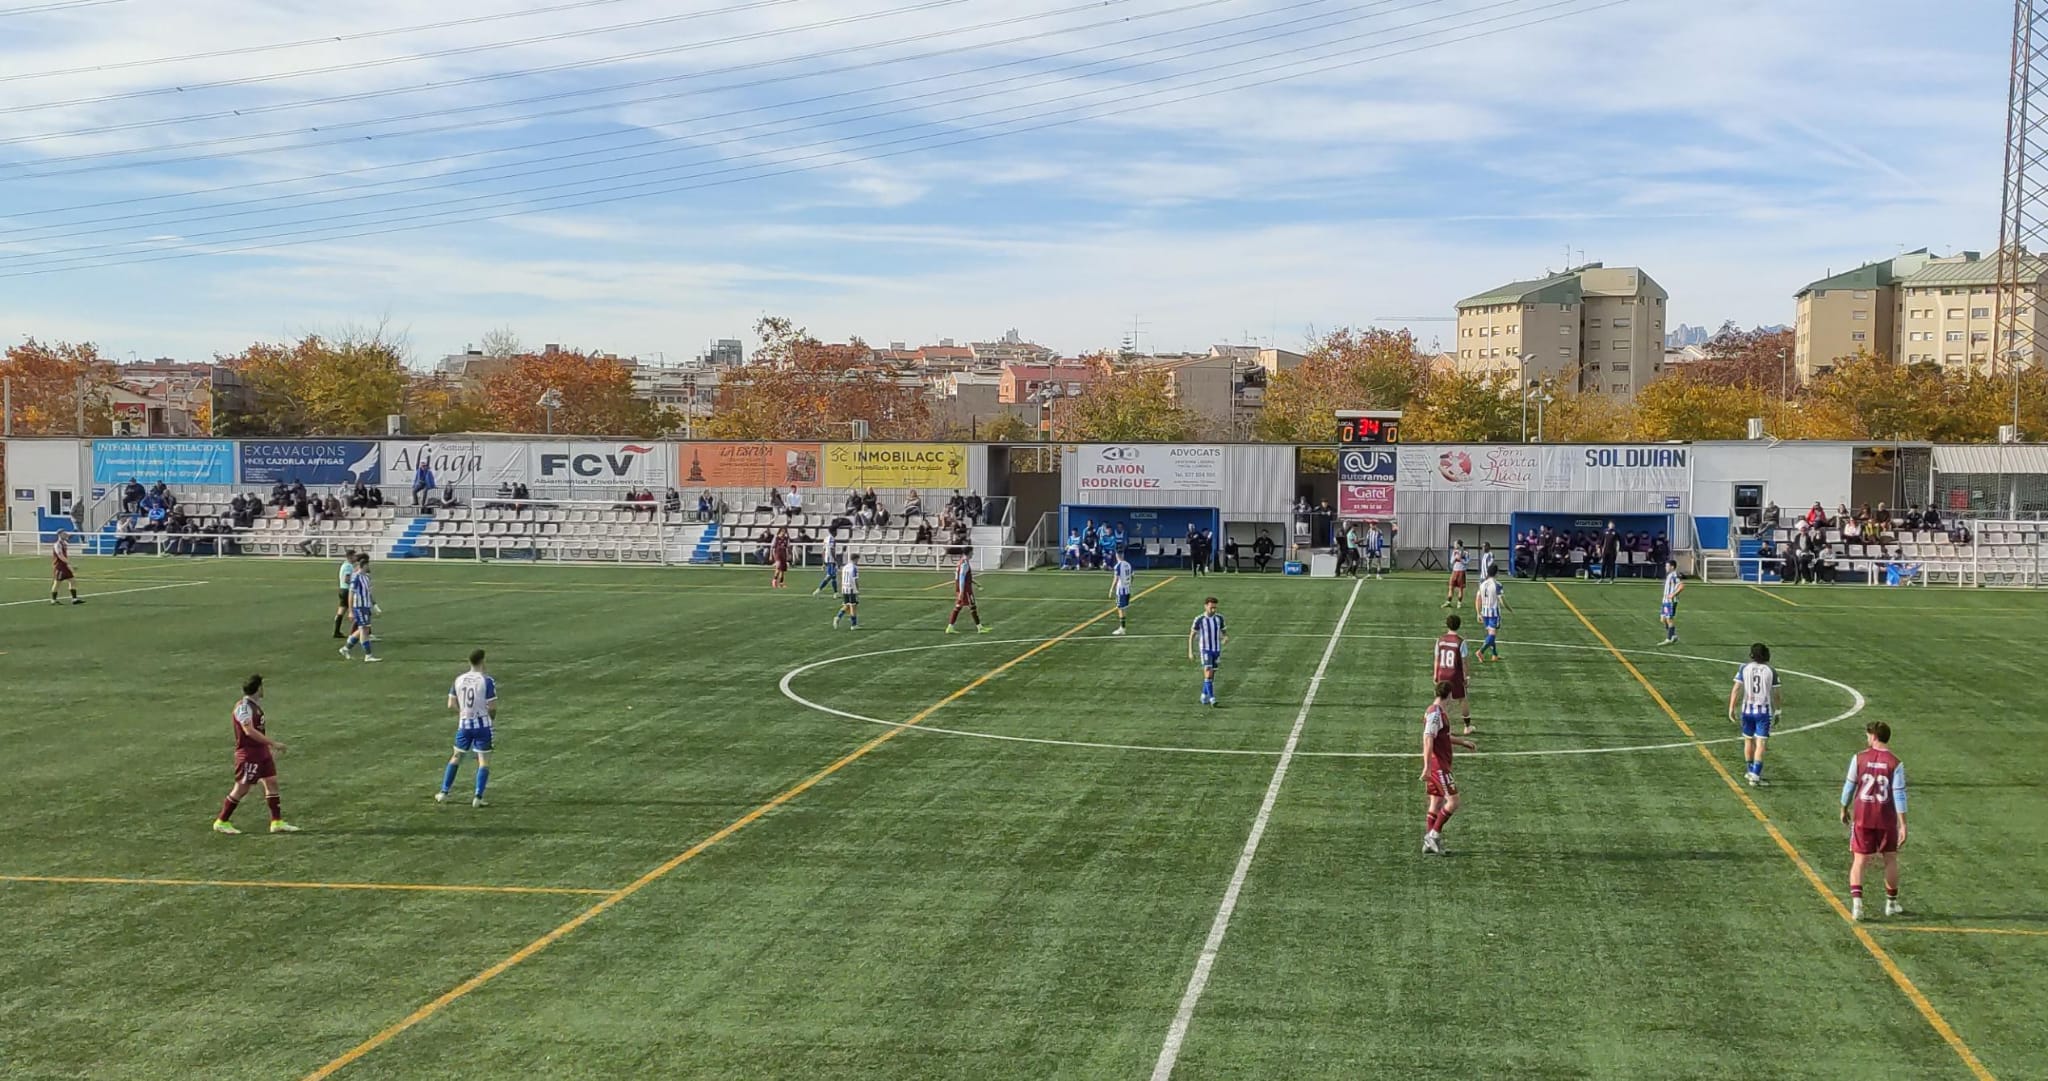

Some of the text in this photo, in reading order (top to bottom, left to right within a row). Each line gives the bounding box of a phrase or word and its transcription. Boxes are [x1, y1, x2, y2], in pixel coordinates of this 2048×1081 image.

[1343, 426, 1354, 442] 0
[1359, 418, 1380, 436] 34
[1386, 427, 1398, 443] 0
[244, 445, 345, 456] EXCAVACIONS
[853, 451, 945, 462] INMOBILACC
[1170, 448, 1221, 457] ADVOCATS
[1487, 450, 1538, 468] Santa
[389, 443, 482, 484] Aliaga
[540, 453, 635, 477] FCV
[1082, 475, 1160, 487] RODRÍGUEZ
[1440, 649, 1455, 669] 18
[1753, 675, 1761, 694] 3
[461, 686, 475, 708] 19
[1859, 773, 1890, 803] 23
